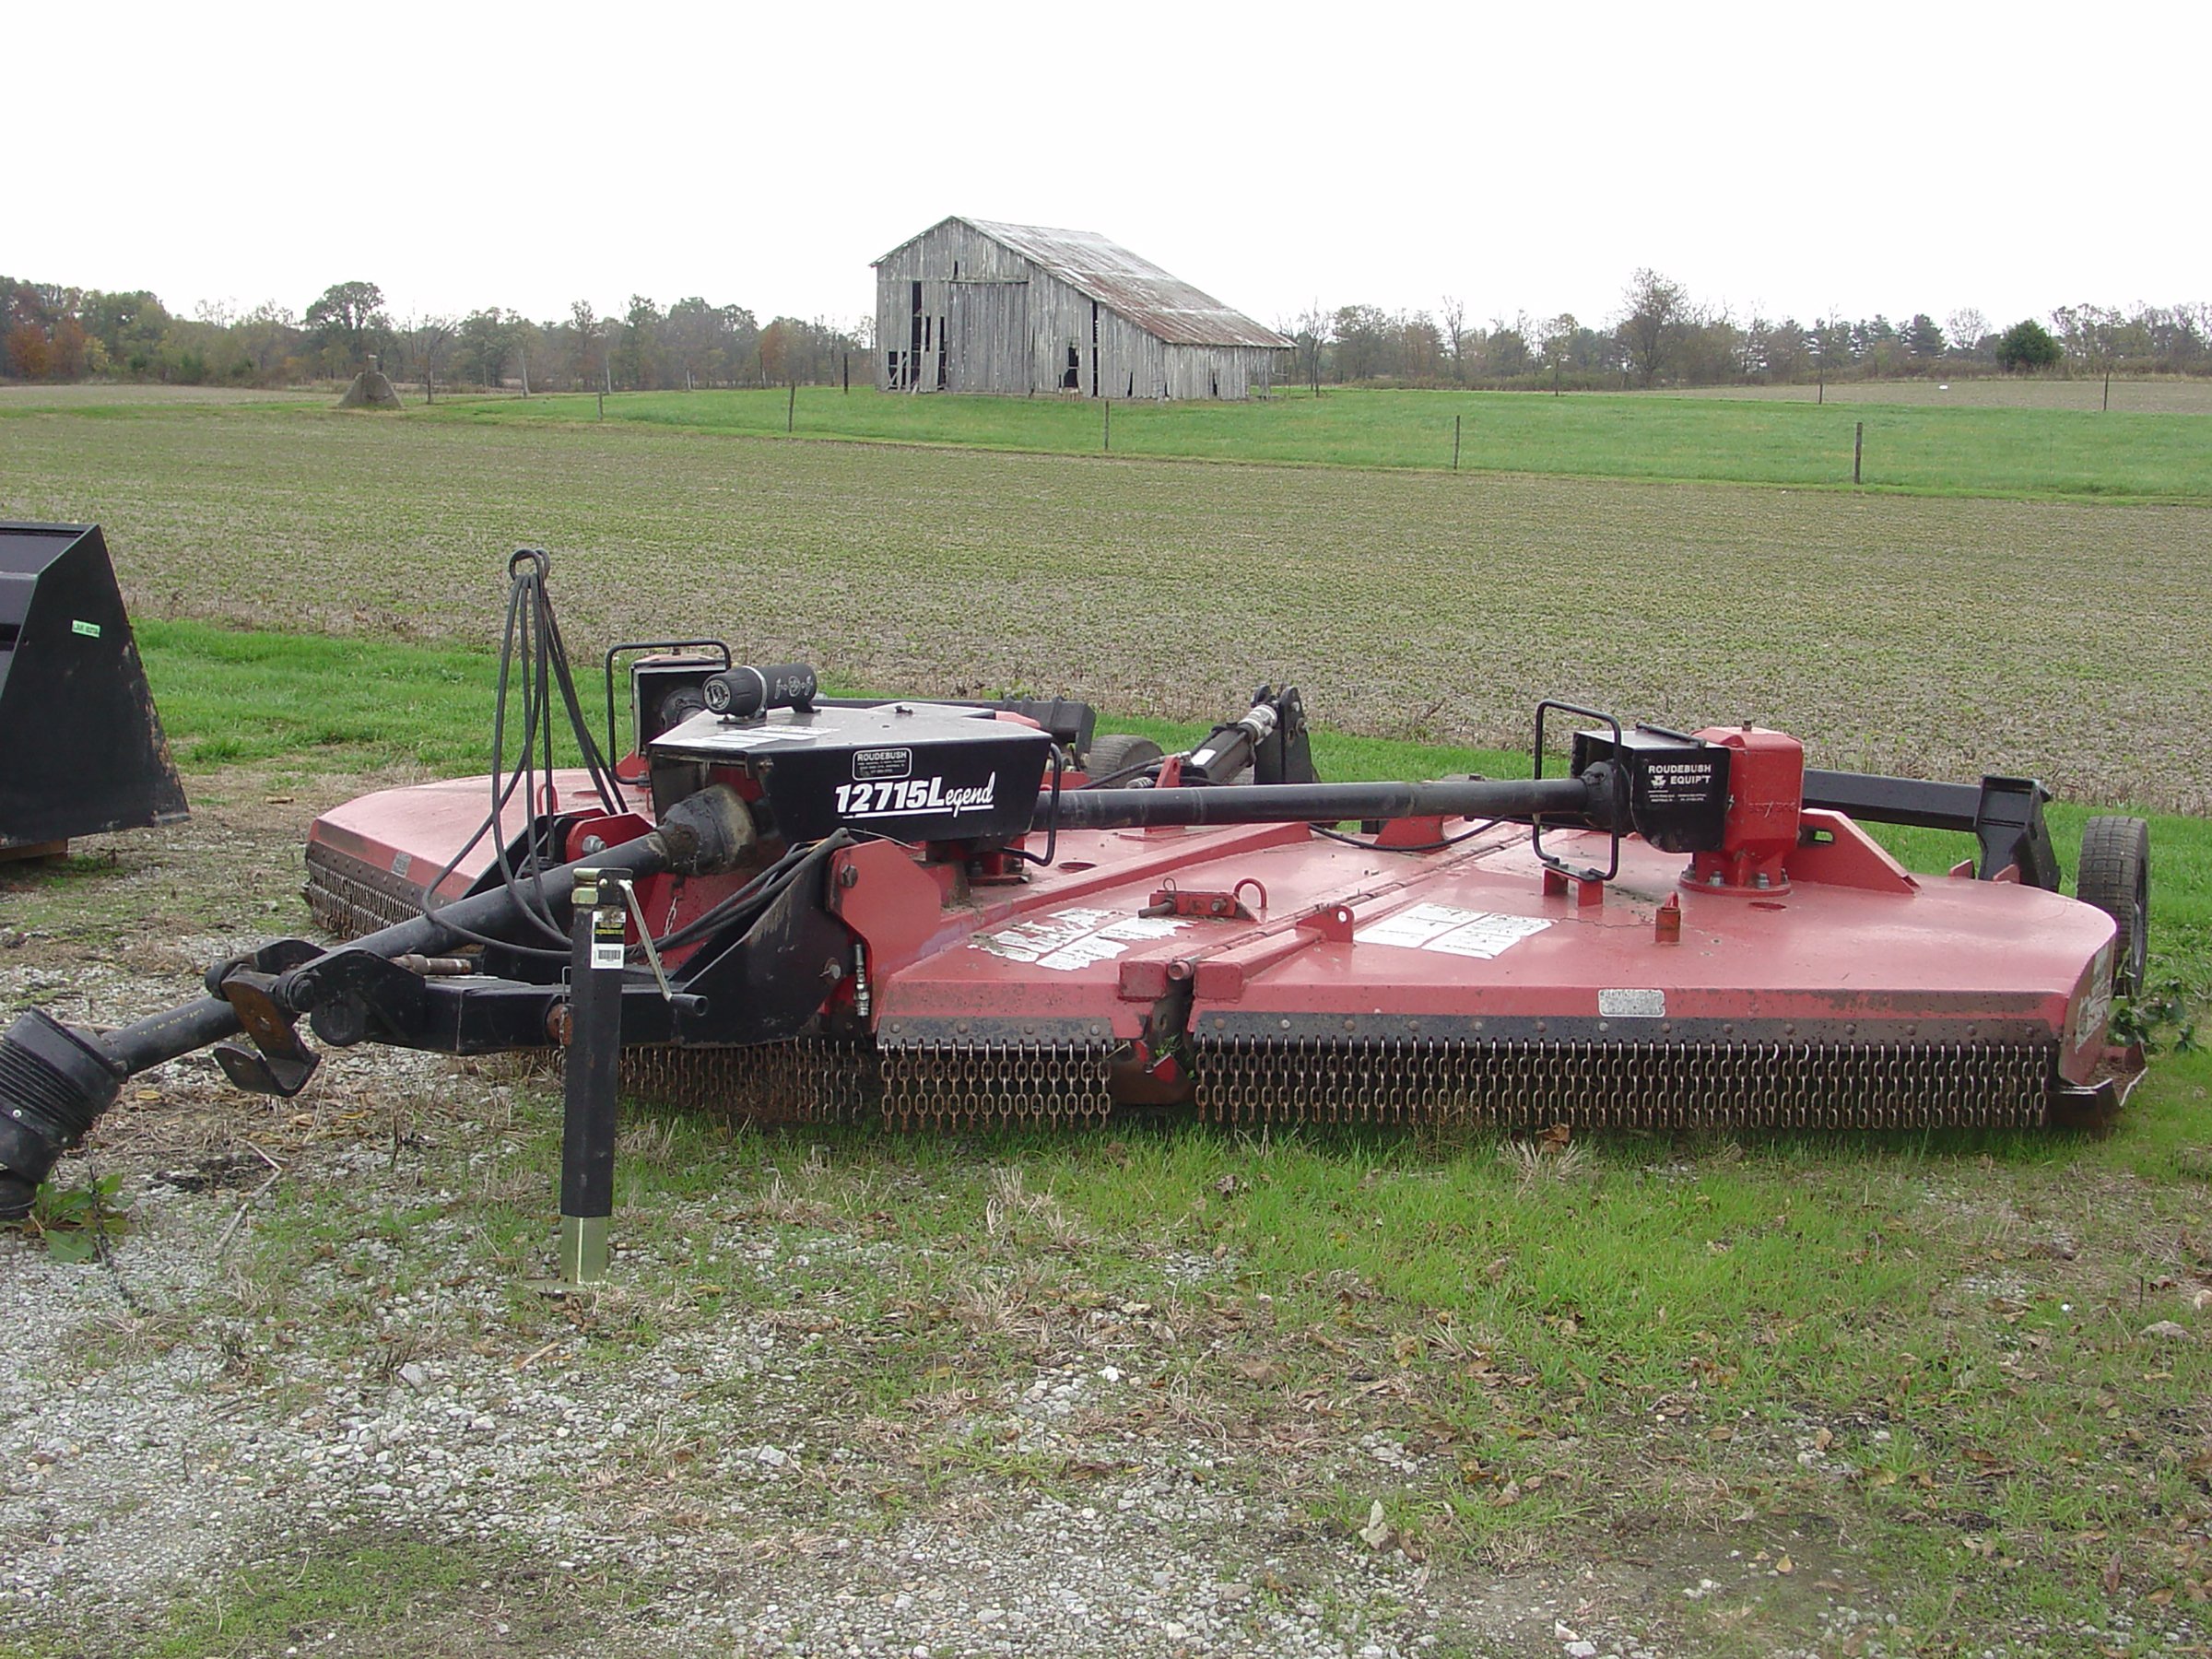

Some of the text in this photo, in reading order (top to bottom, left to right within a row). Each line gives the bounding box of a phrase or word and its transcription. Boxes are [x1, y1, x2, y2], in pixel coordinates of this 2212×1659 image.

[857, 751, 907, 761] ROUDEBUSH
[1648, 764, 1712, 774] ROUDEBUSH
[1670, 775, 1712, 785] EQUIP'T
